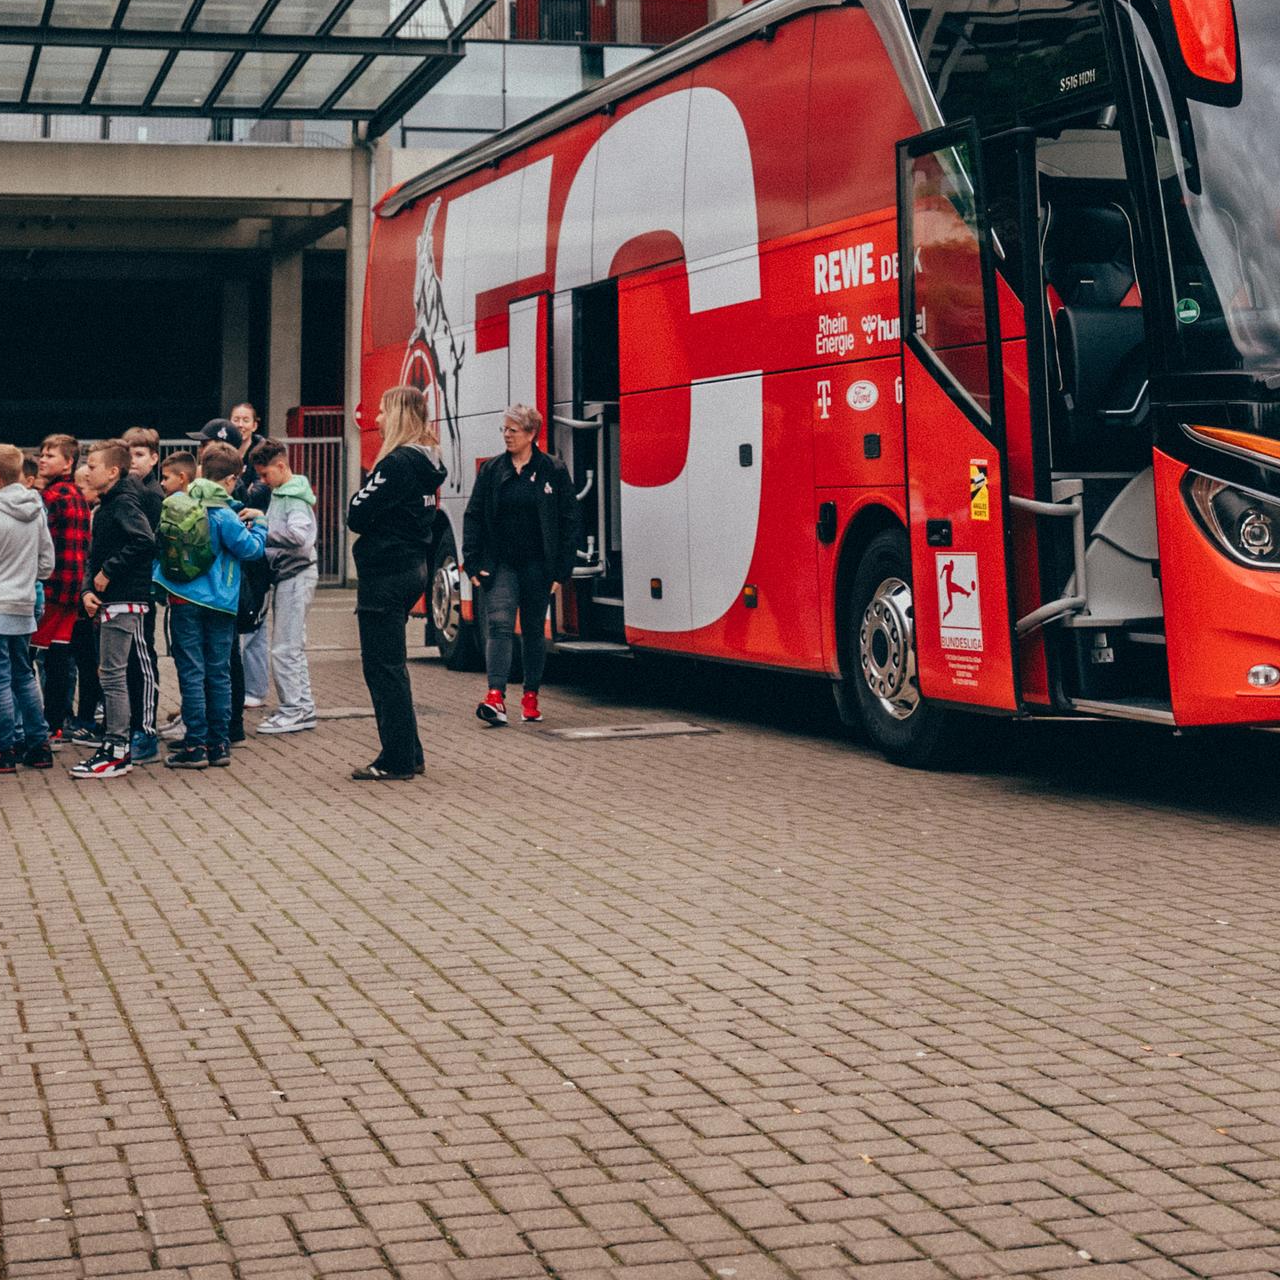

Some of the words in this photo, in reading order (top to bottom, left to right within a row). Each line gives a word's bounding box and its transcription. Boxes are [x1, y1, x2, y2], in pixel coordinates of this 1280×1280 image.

[814, 241, 876, 295] REWE
[818, 312, 848, 336] Rhein
[815, 333, 855, 357] Energie
[941, 635, 982, 650] BUNDESLIGA
